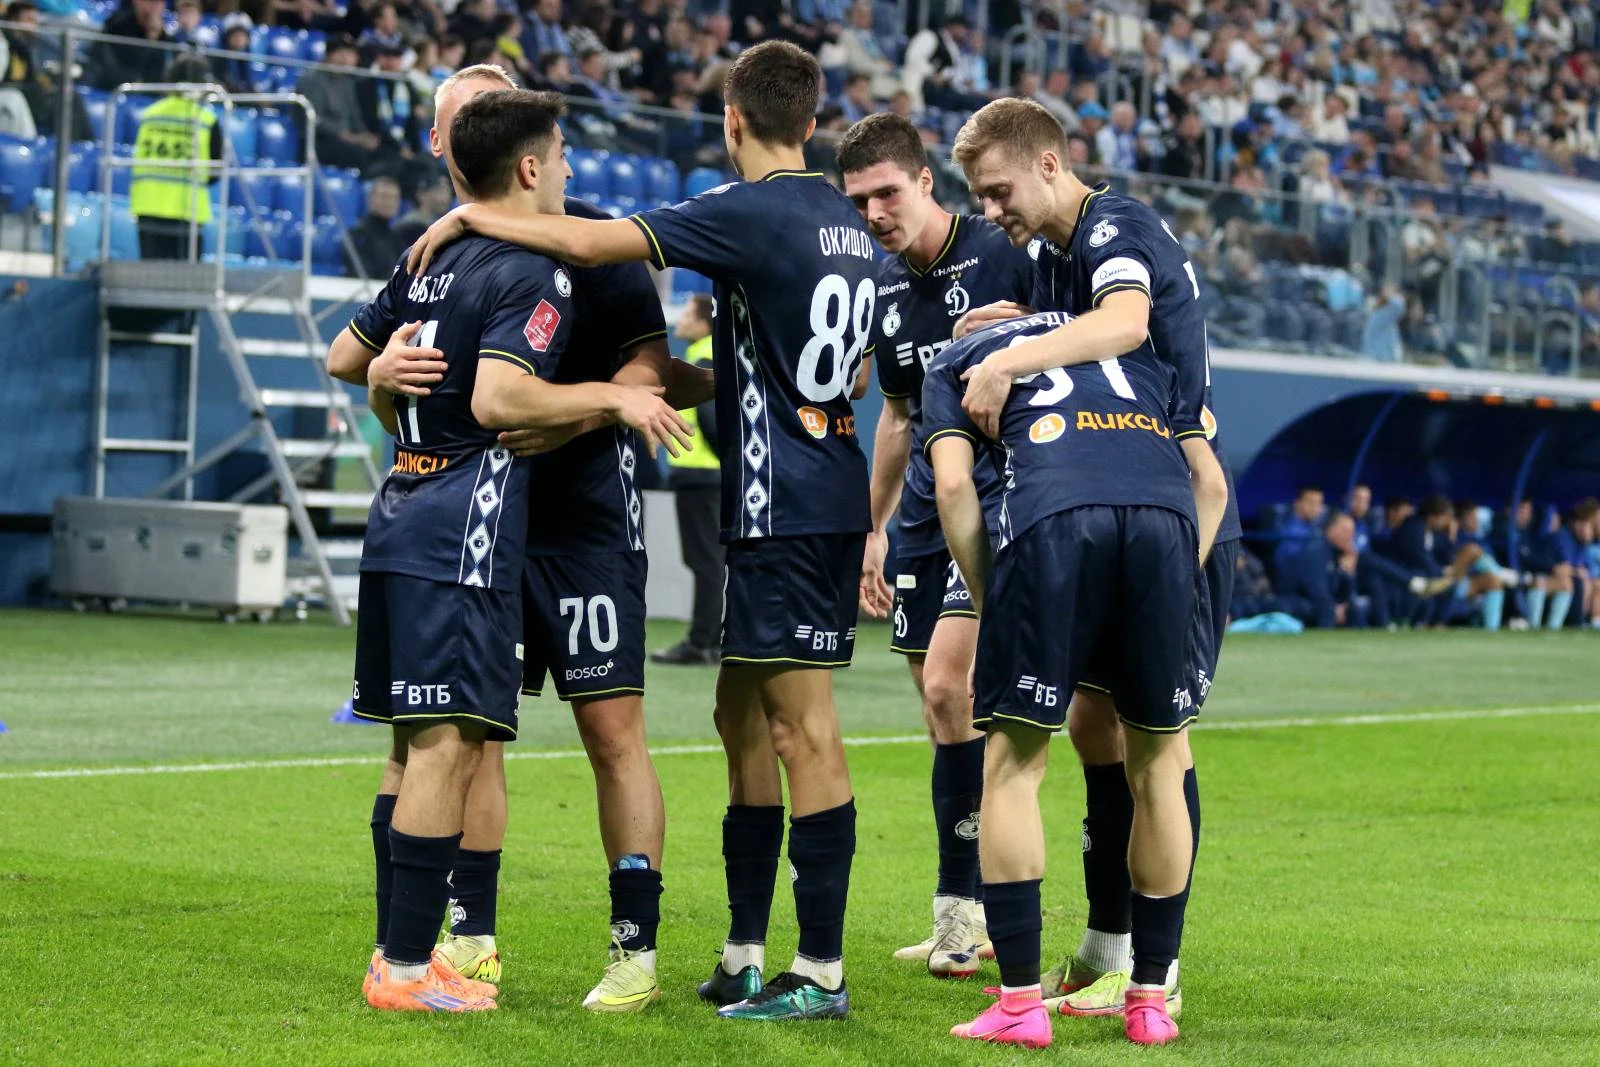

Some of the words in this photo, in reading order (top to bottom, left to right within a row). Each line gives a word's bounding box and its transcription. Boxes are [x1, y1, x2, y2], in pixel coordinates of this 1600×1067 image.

[933, 257, 979, 277] CHANGAN
[877, 281, 910, 296] ildberries
[797, 274, 875, 402] 88
[1076, 411, 1170, 440] ДИКСИ
[560, 594, 619, 656] 70
[812, 631, 839, 651] ВТБ
[565, 665, 608, 682] BOSCO
[407, 684, 451, 705] ВТБ
[1035, 683, 1057, 707] ВБ
